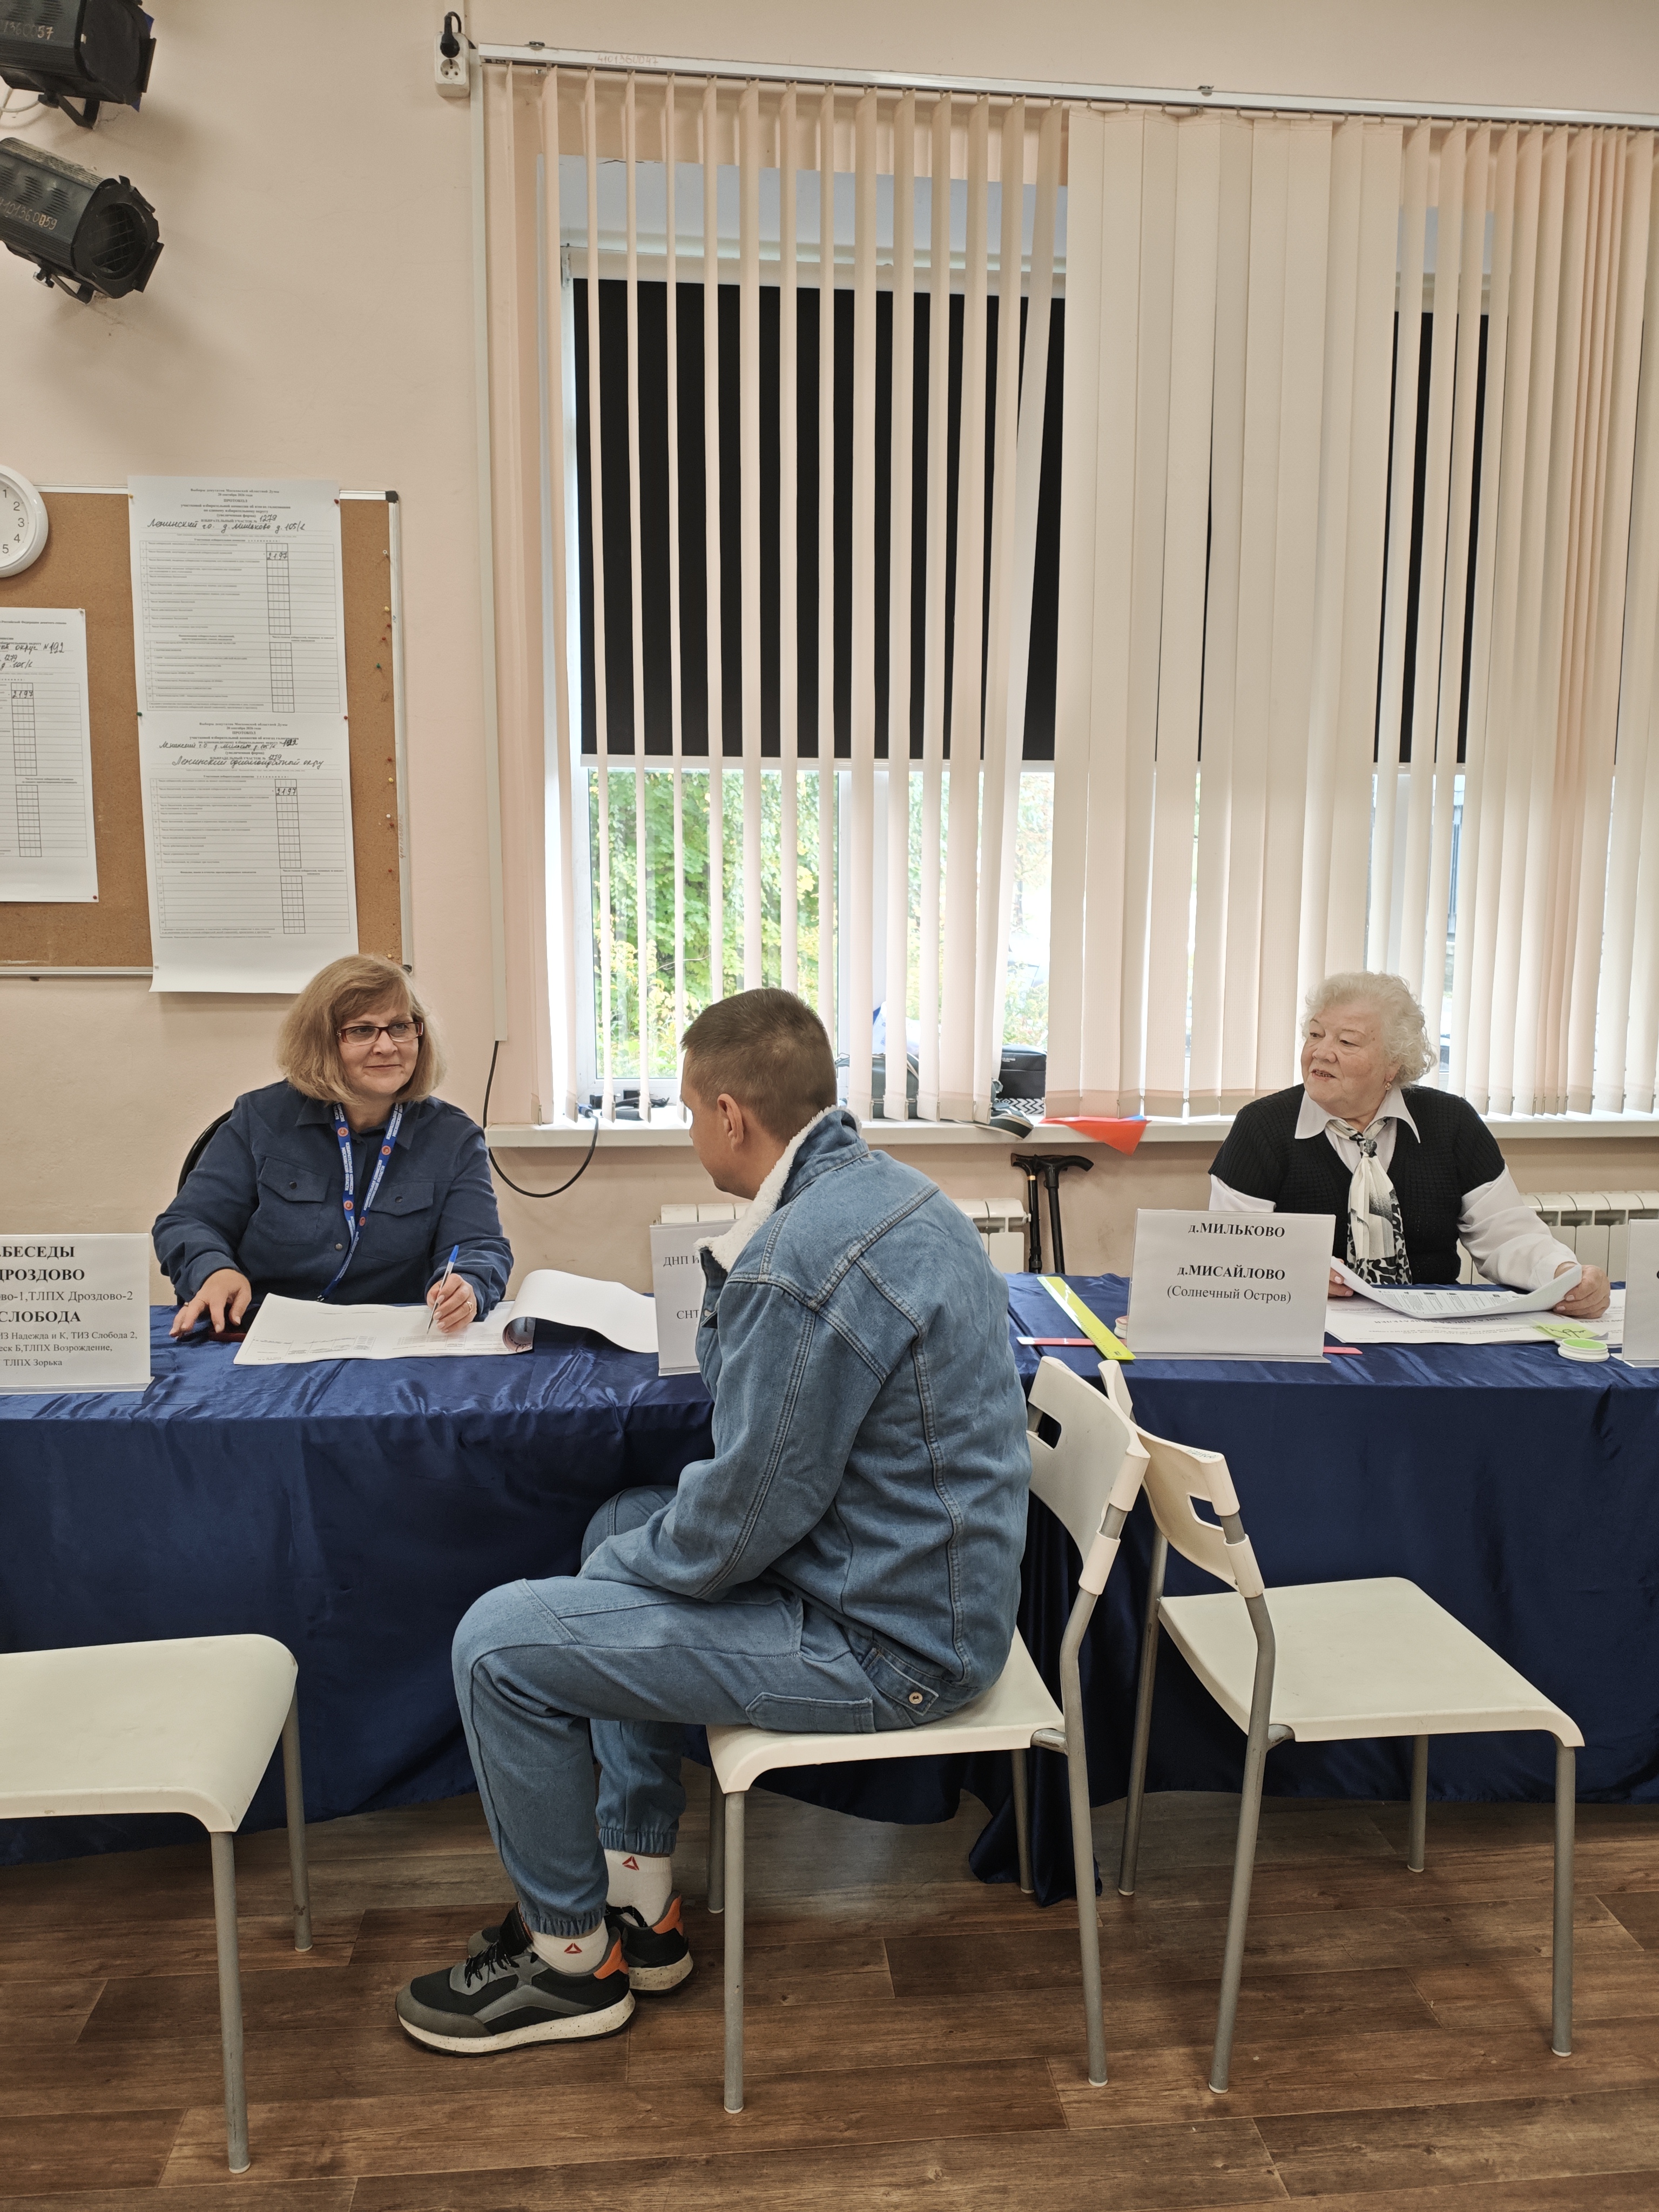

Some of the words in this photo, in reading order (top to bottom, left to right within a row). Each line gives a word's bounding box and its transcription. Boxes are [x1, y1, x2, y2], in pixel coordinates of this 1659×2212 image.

[2, 489, 7, 498] 1
[13, 501, 21, 511] 2
[18, 517, 25, 528] 3
[259, 514, 278, 522] 1279
[14, 534, 21, 543] 4
[2, 544, 9, 554] 5
[1188, 1222, 1285, 1238] д.МИЛЬКОВО
[663, 1256, 689, 1267] ДНП
[1177, 1264, 1286, 1280] д.МИСАЙЛОВО
[68, 1291, 133, 1303] Дроздово-2
[1167, 1285, 1240, 1299] (Солнечный
[1243, 1289, 1292, 1305] Остров)
[0, 1311, 82, 1325] СЛОБОДА
[11, 1332, 49, 1340] Надежда
[59, 1332, 69, 1340] К,
[91, 1331, 128, 1339] Слобода
[130, 1331, 138, 1340] 2,
[53, 1344, 113, 1353] Возрождение,
[3, 1359, 31, 1367] ТЛПХ
[33, 1358, 63, 1368] Зорька
